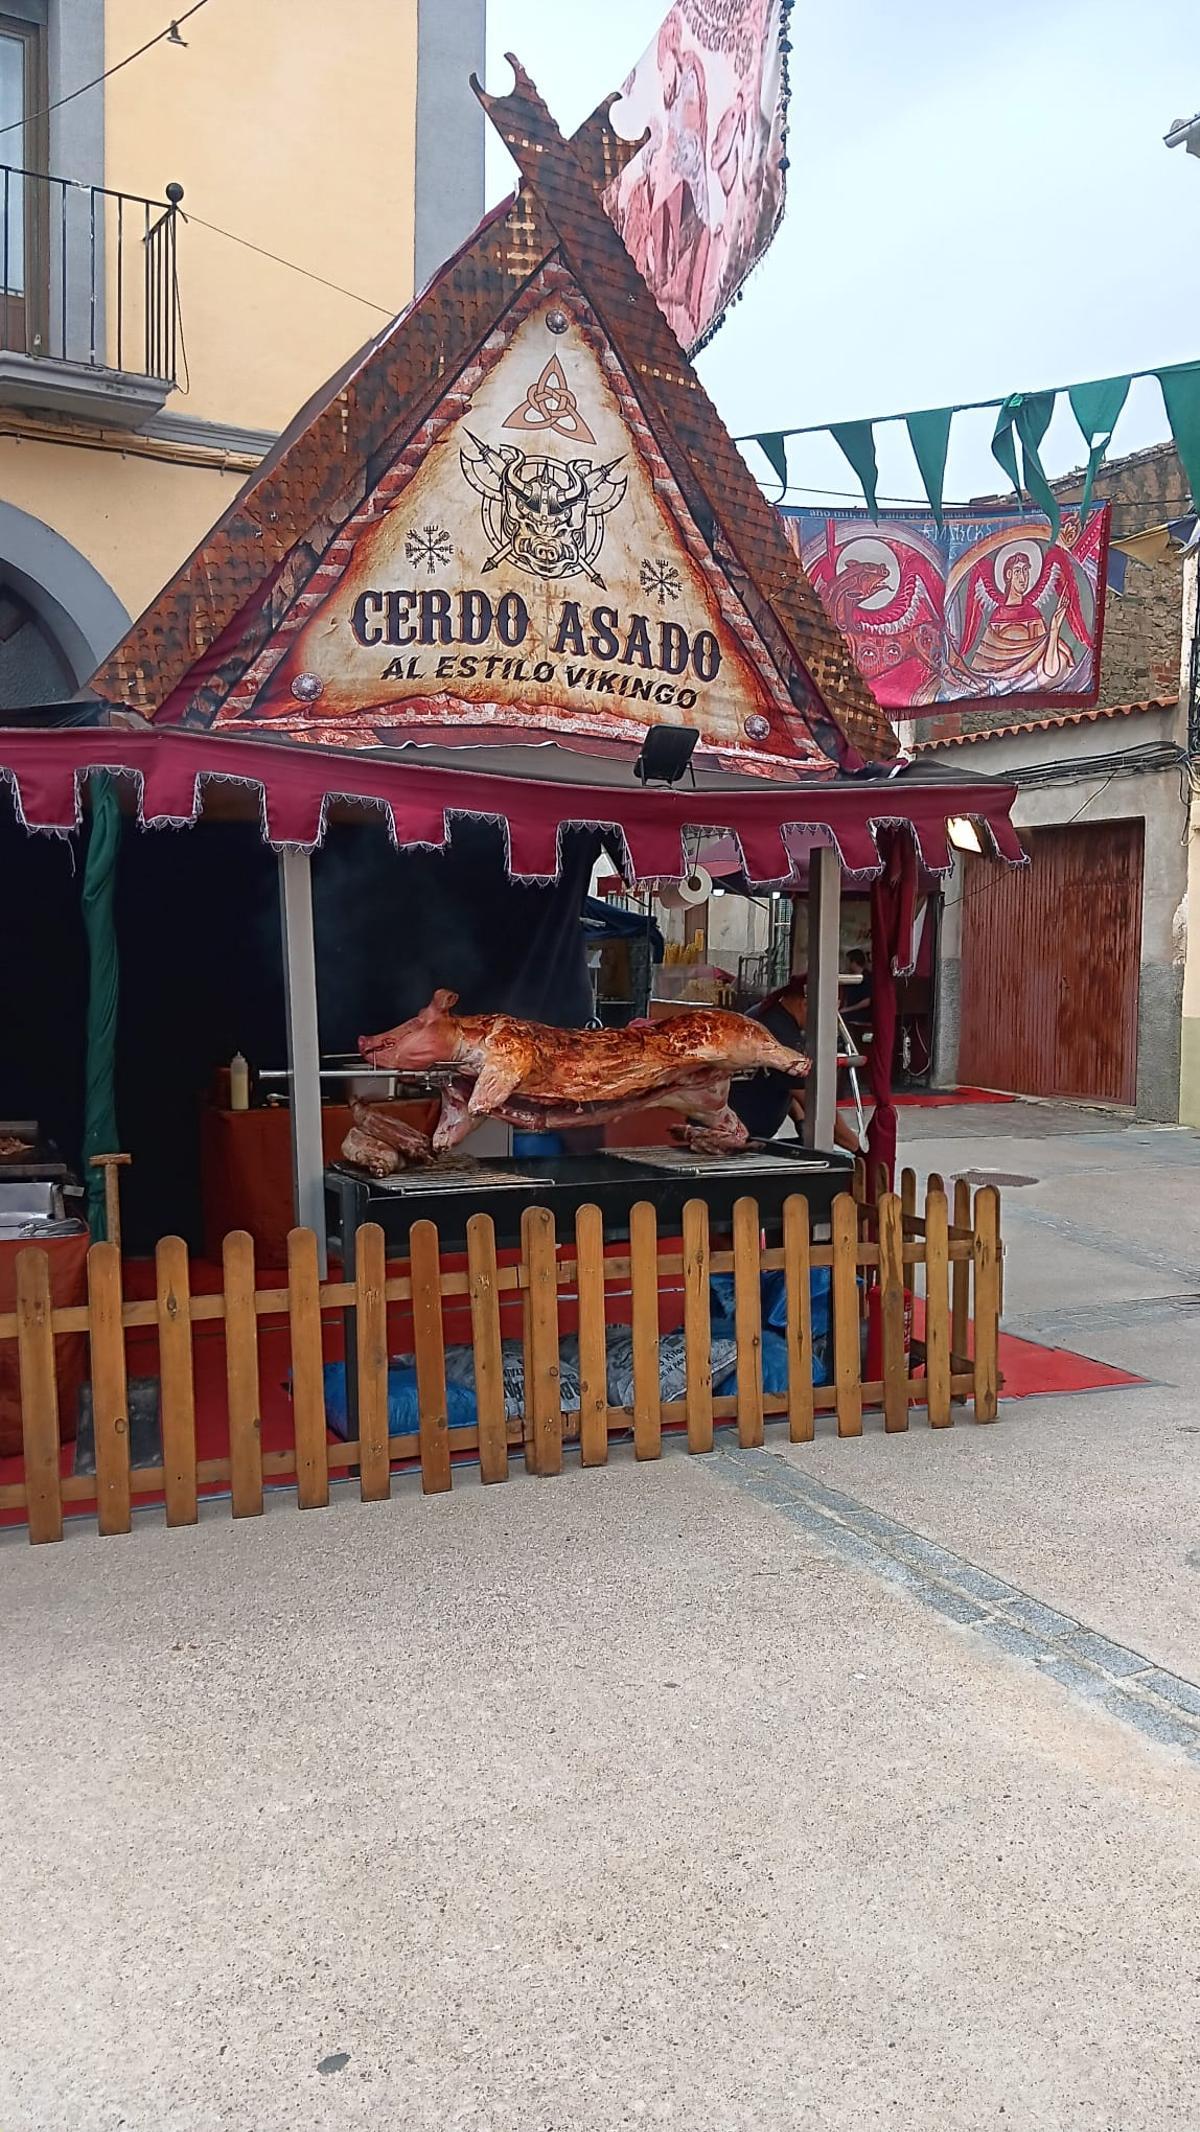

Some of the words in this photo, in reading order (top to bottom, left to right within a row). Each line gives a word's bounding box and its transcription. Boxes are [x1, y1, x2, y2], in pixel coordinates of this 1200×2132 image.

[348, 589, 530, 647] CERDO
[549, 600, 722, 682] ASADO
[380, 654, 426, 680] AL
[435, 654, 556, 683] ESTILO
[566, 664, 700, 709] VIKINGO
